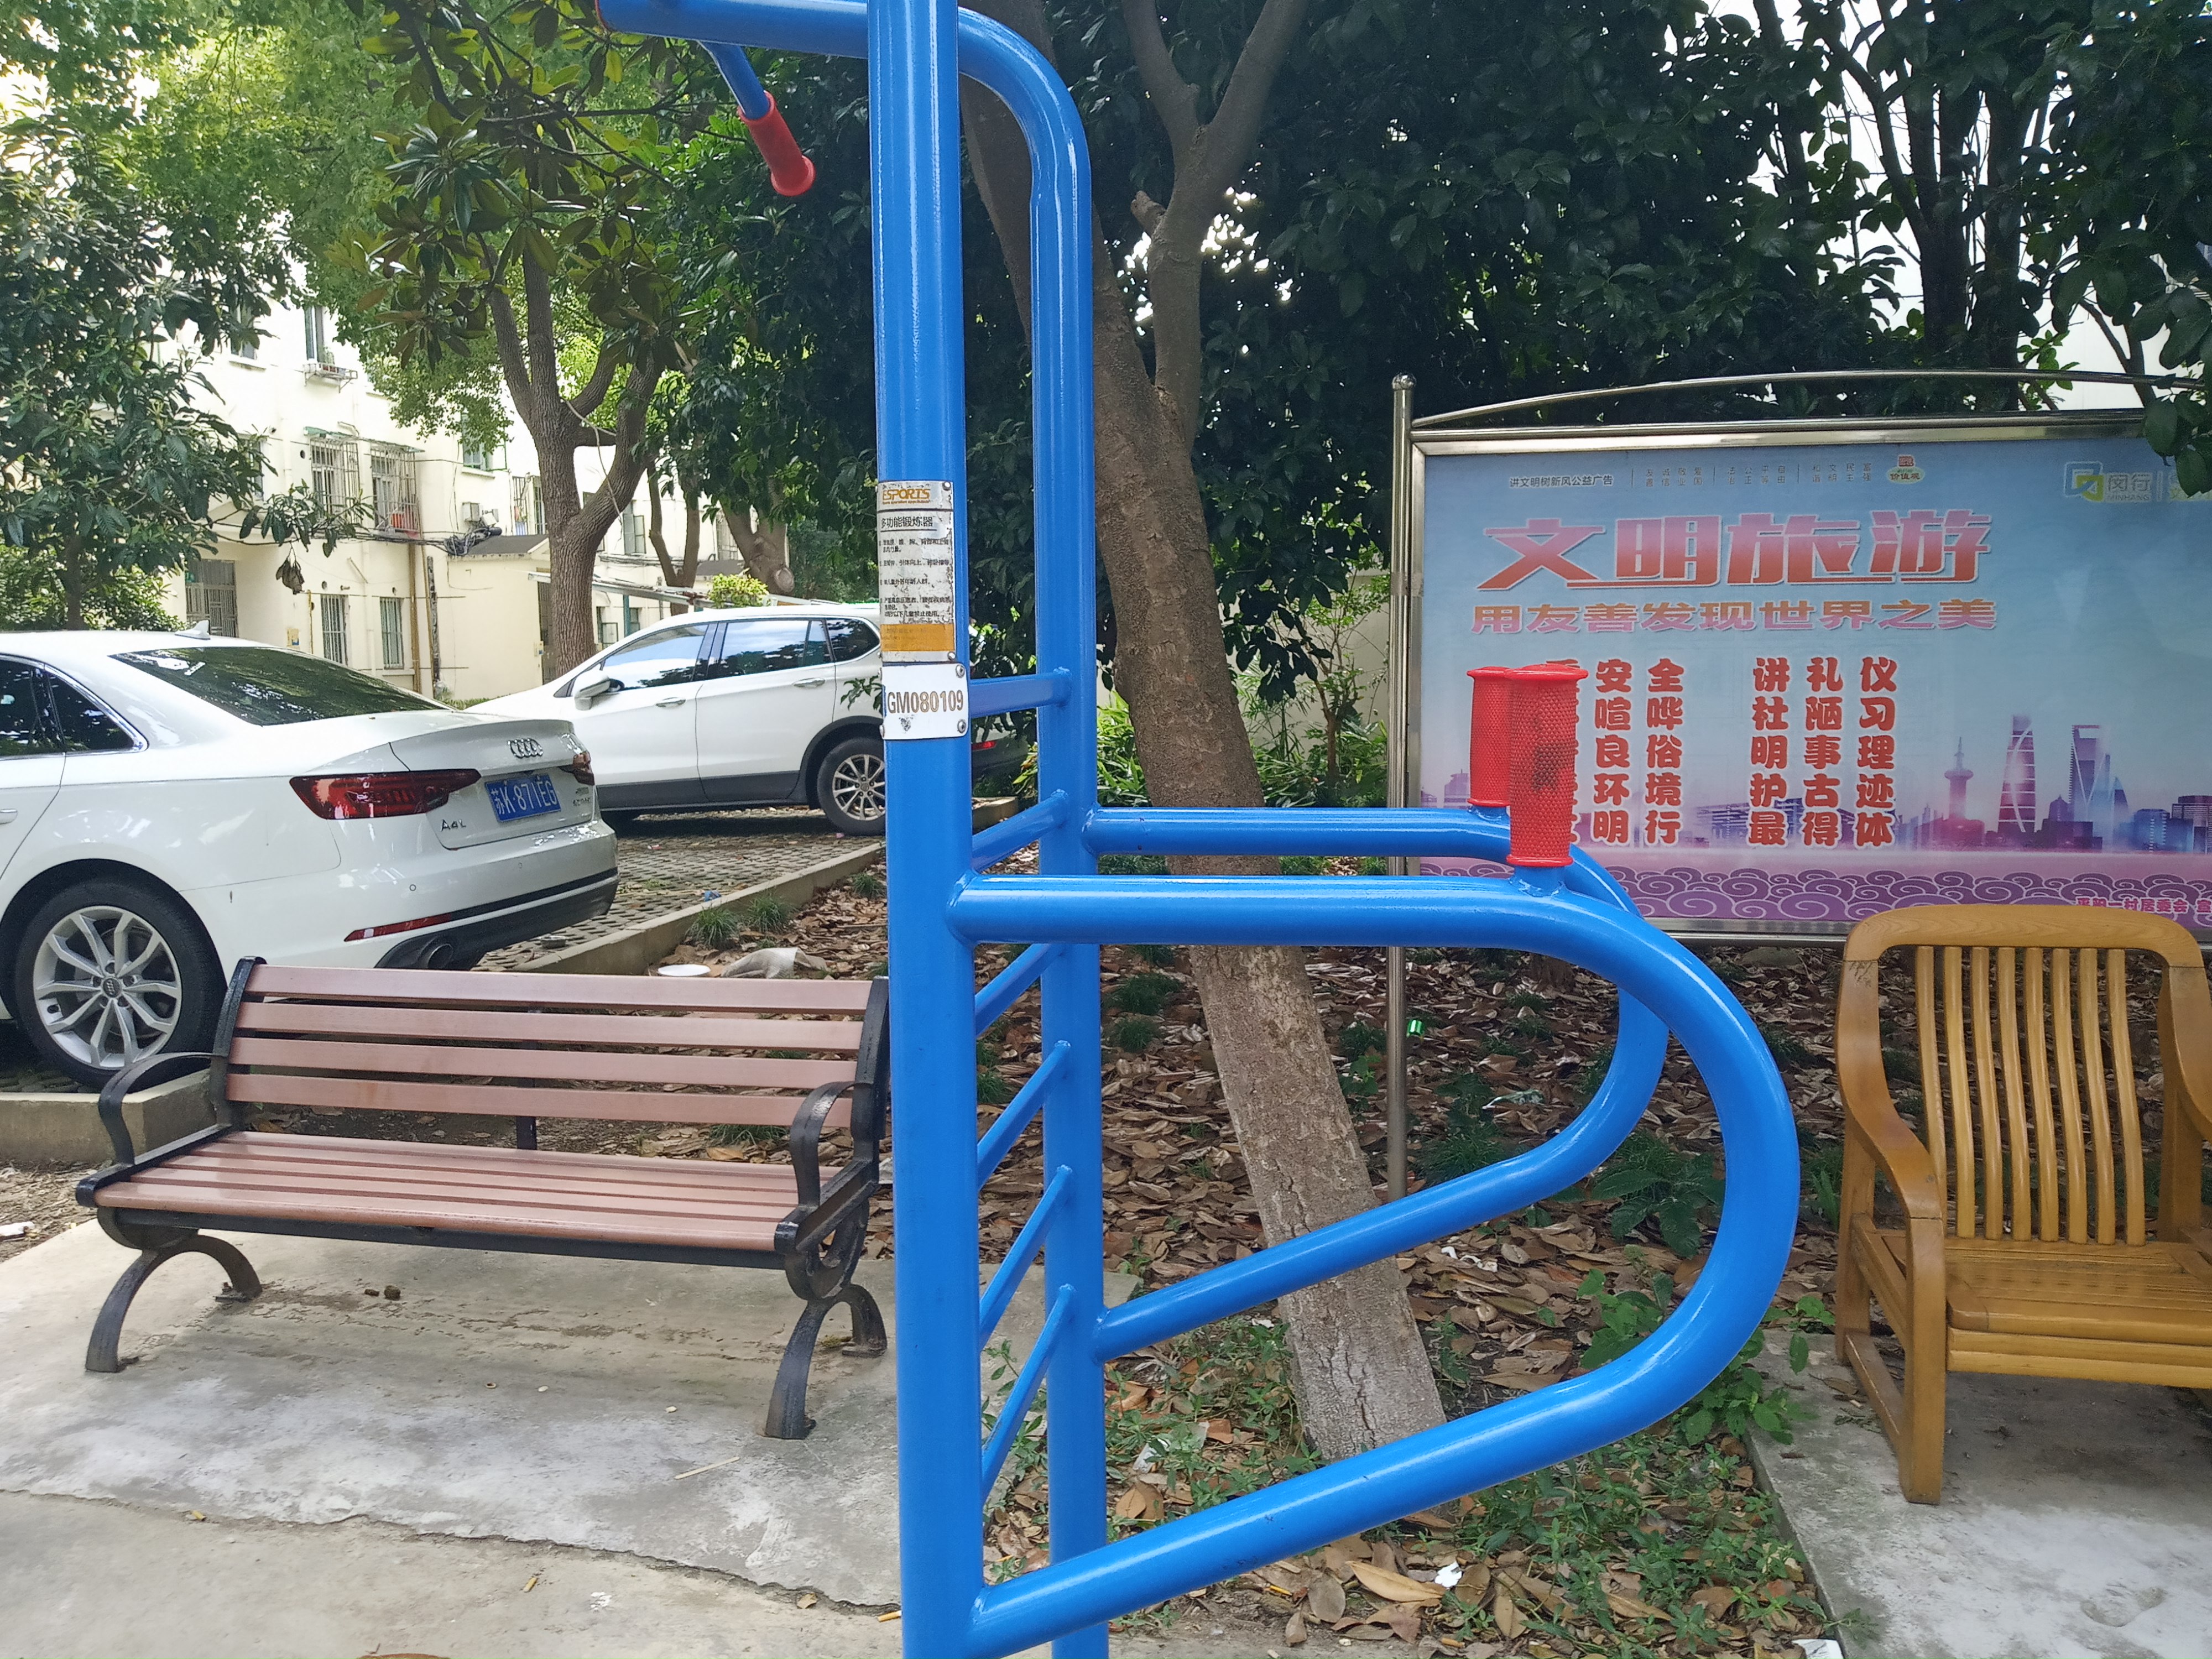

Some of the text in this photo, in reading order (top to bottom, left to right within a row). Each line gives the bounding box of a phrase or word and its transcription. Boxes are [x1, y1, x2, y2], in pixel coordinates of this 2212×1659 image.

[1509, 474, 1614, 488] 讲文明树新风公益广告
[881, 516, 933, 529] 多功能锻炼器
[1476, 509, 1991, 592] 文明旅游
[1472, 599, 1997, 634] 用友善发现世界之美
[1752, 656, 1897, 692] 讲礼仪
[888, 690, 963, 713] GM080109
[1752, 696, 1895, 731] 杜陋习
[1751, 734, 1895, 769] 明事理
[1750, 773, 1893, 808] 护古迹
[1749, 811, 1893, 847] 最得体
